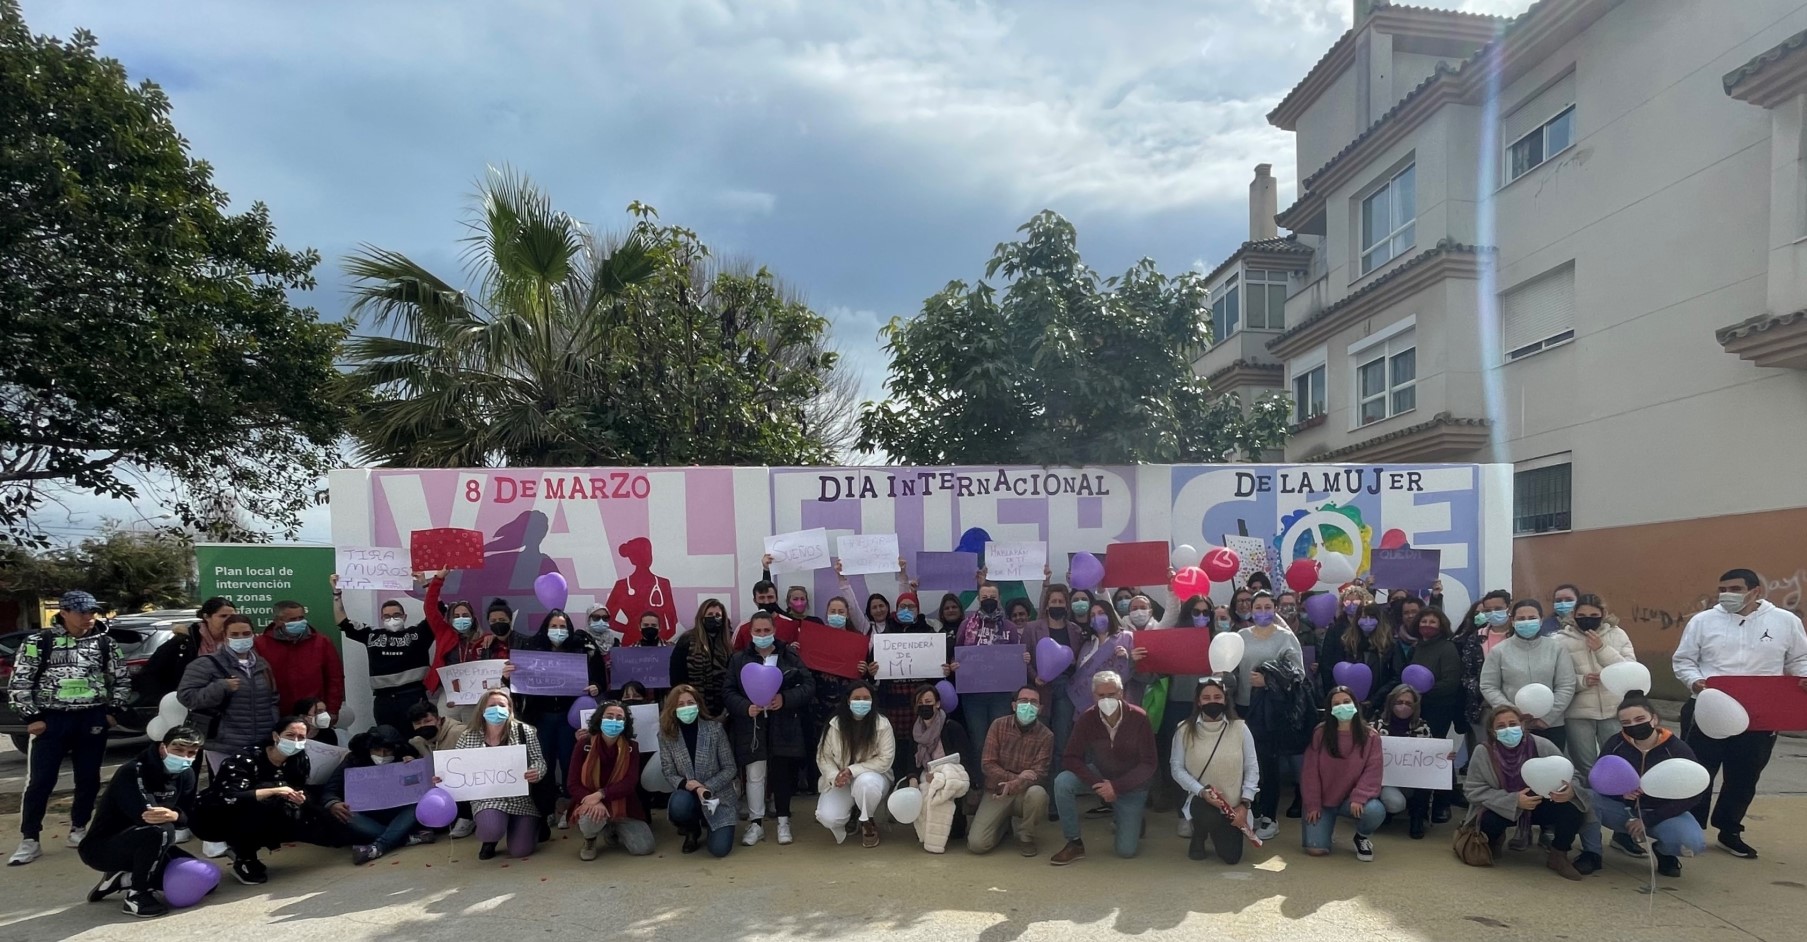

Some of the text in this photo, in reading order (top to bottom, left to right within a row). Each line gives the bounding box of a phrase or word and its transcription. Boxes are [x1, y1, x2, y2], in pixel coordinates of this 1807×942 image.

[465, 479, 481, 503] 8
[544, 472, 651, 500] MARZO
[818, 475, 878, 502] DIA
[1280, 471, 1315, 494] LA
[343, 549, 395, 561] TIRA
[215, 566, 294, 576] Plan local de
[345, 562, 410, 577] MUROS
[216, 579, 291, 589] intervención
[236, 593, 273, 602] zonas
[882, 636, 935, 651] DEPENDERÁ
[896, 651, 912, 659] DE
